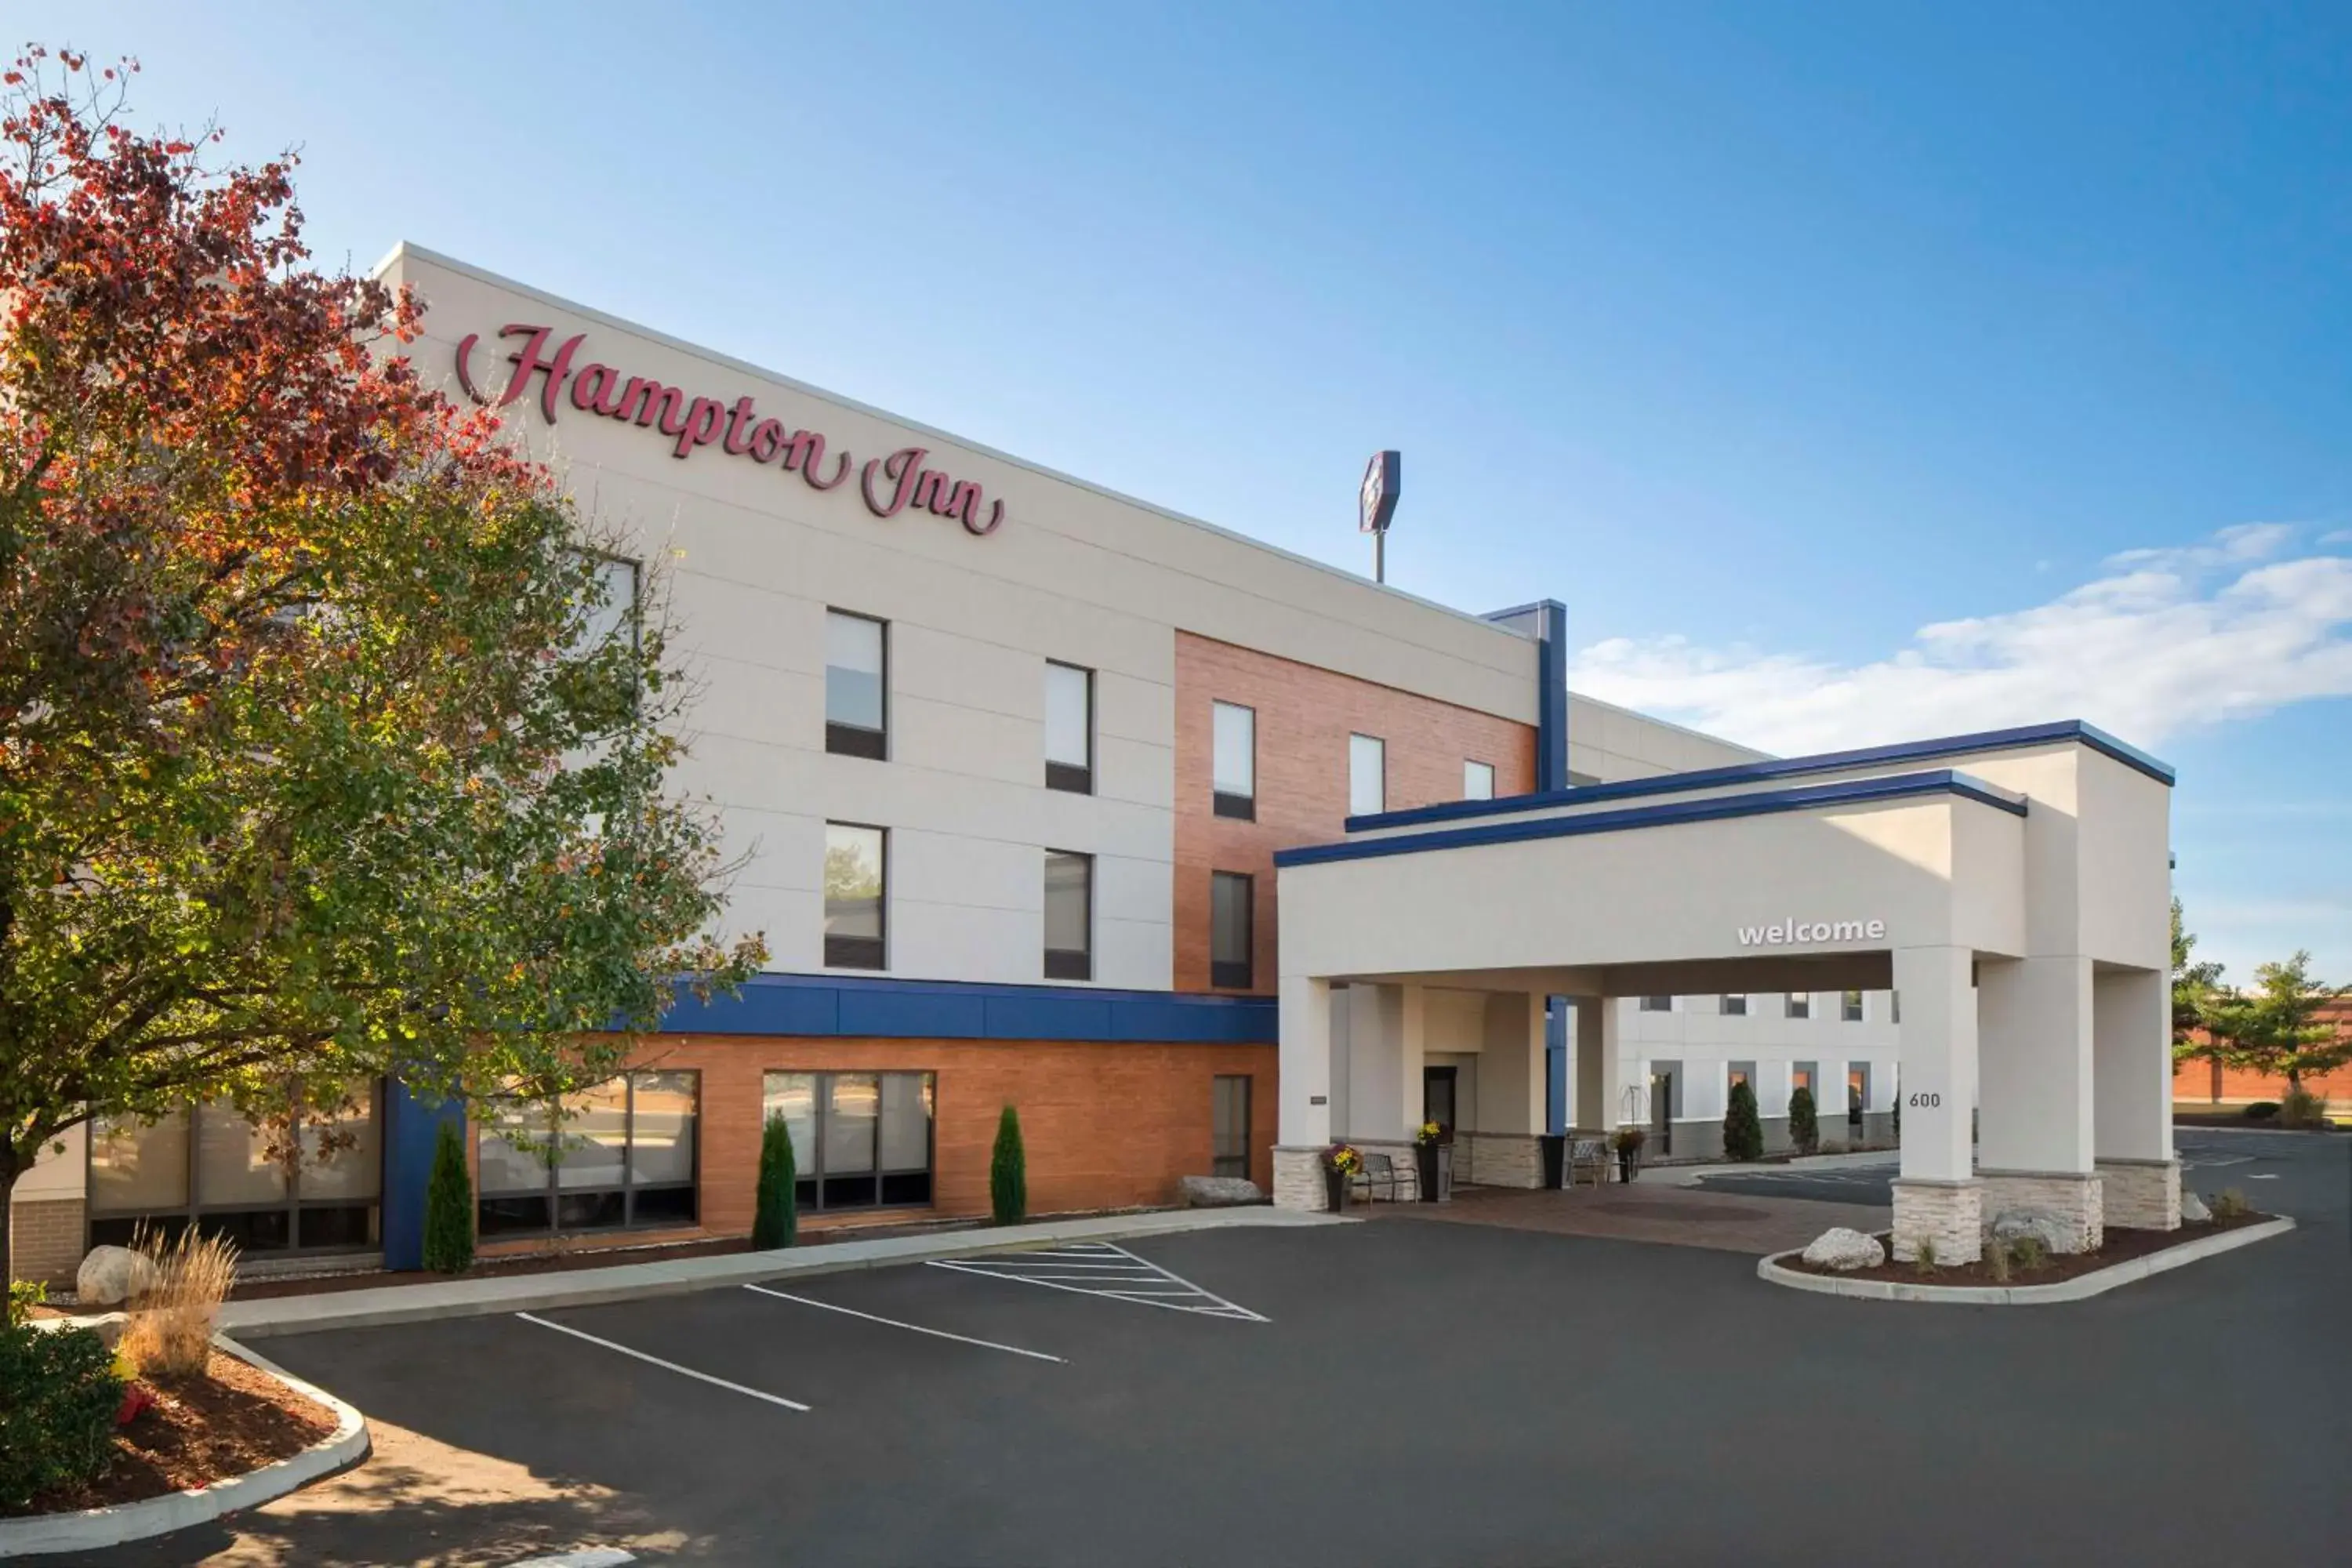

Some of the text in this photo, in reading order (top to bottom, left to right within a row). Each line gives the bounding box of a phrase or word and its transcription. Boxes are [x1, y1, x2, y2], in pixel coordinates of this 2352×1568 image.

[456, 323, 1005, 536] Hampton Inn
[1737, 916, 1886, 946] welcome
[1909, 1093, 1940, 1108] 600
